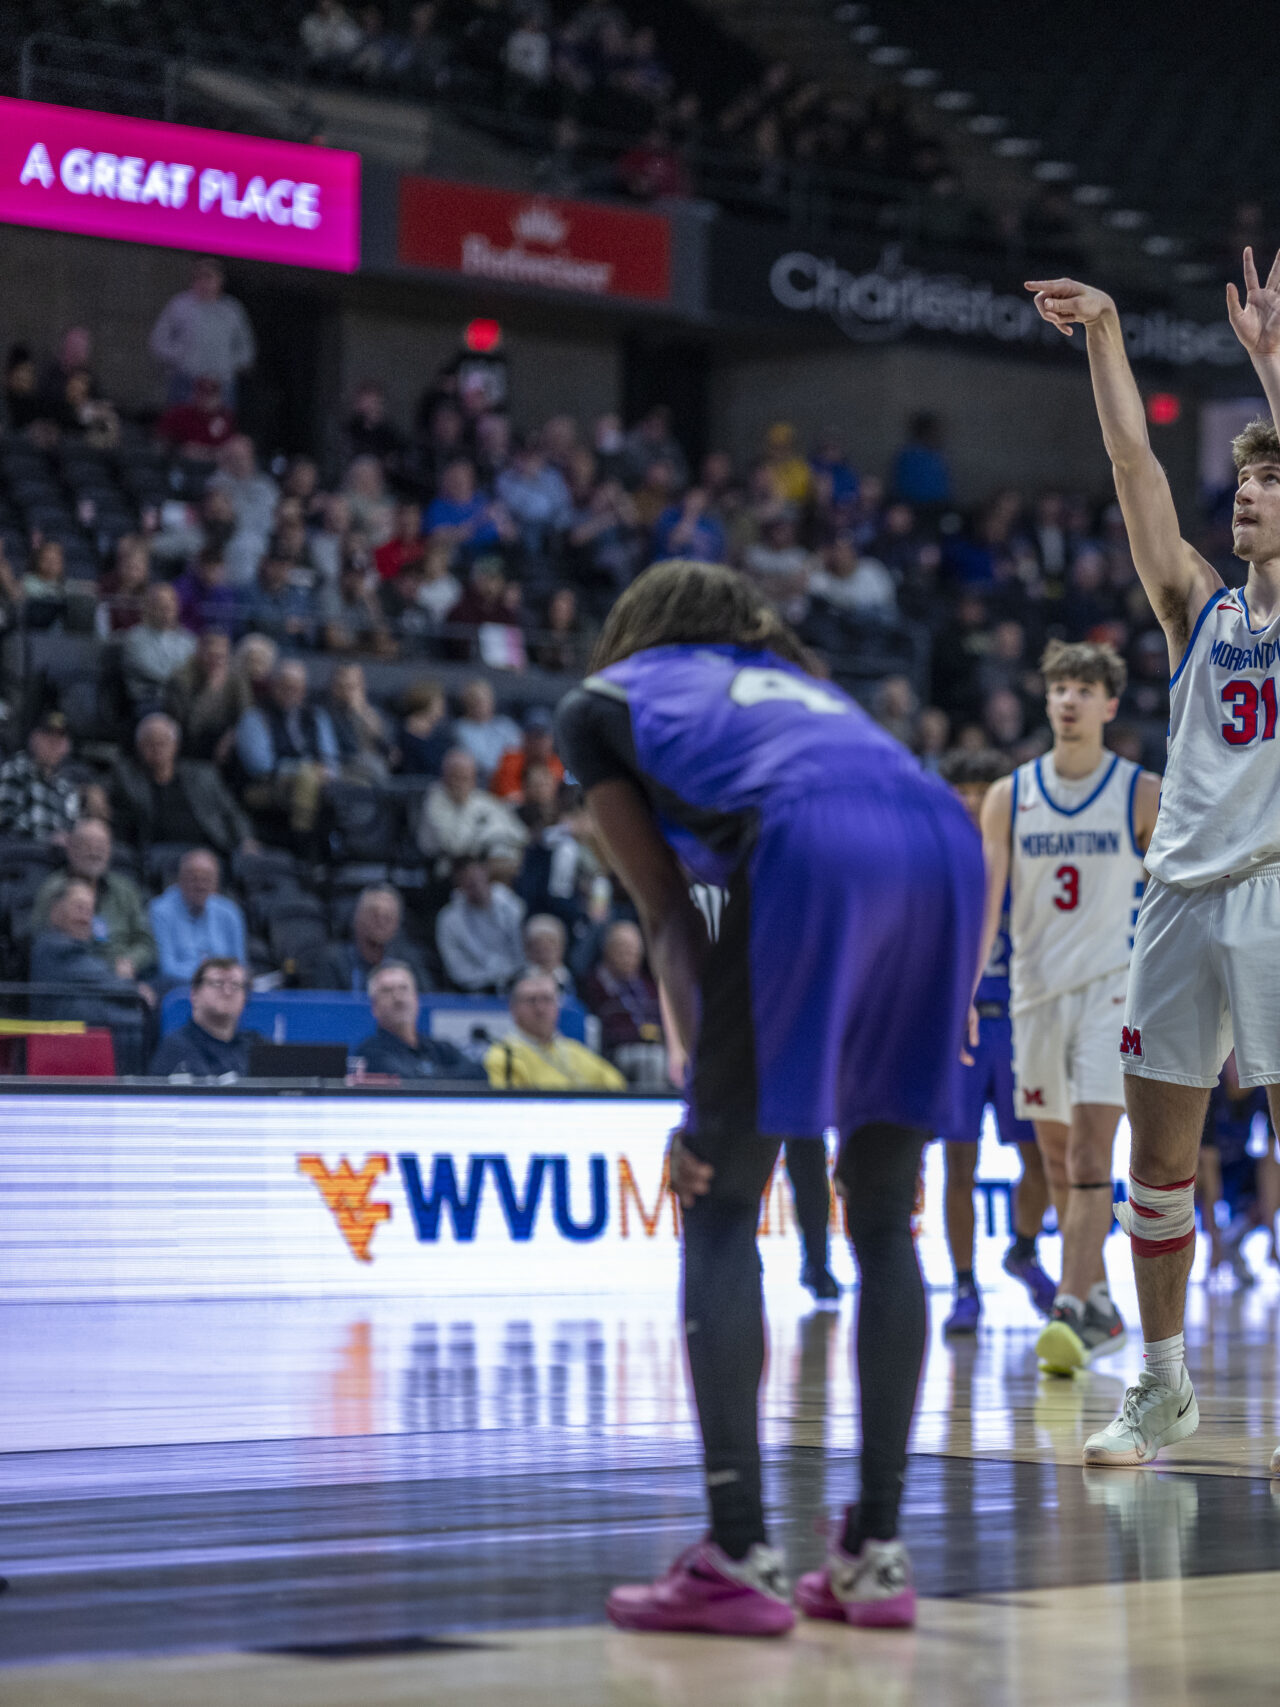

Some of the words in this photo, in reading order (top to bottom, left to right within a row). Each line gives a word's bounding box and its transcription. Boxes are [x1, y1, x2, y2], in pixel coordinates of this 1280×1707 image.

[19, 142, 55, 189] A
[59, 147, 196, 210] GREAT
[198, 167, 322, 230] PLACE
[729, 666, 847, 715] 4
[1221, 677, 1278, 745] 31
[1019, 831, 1119, 857] MORGANTOWN
[1053, 864, 1080, 912] 3
[1120, 1025, 1143, 1057] M
